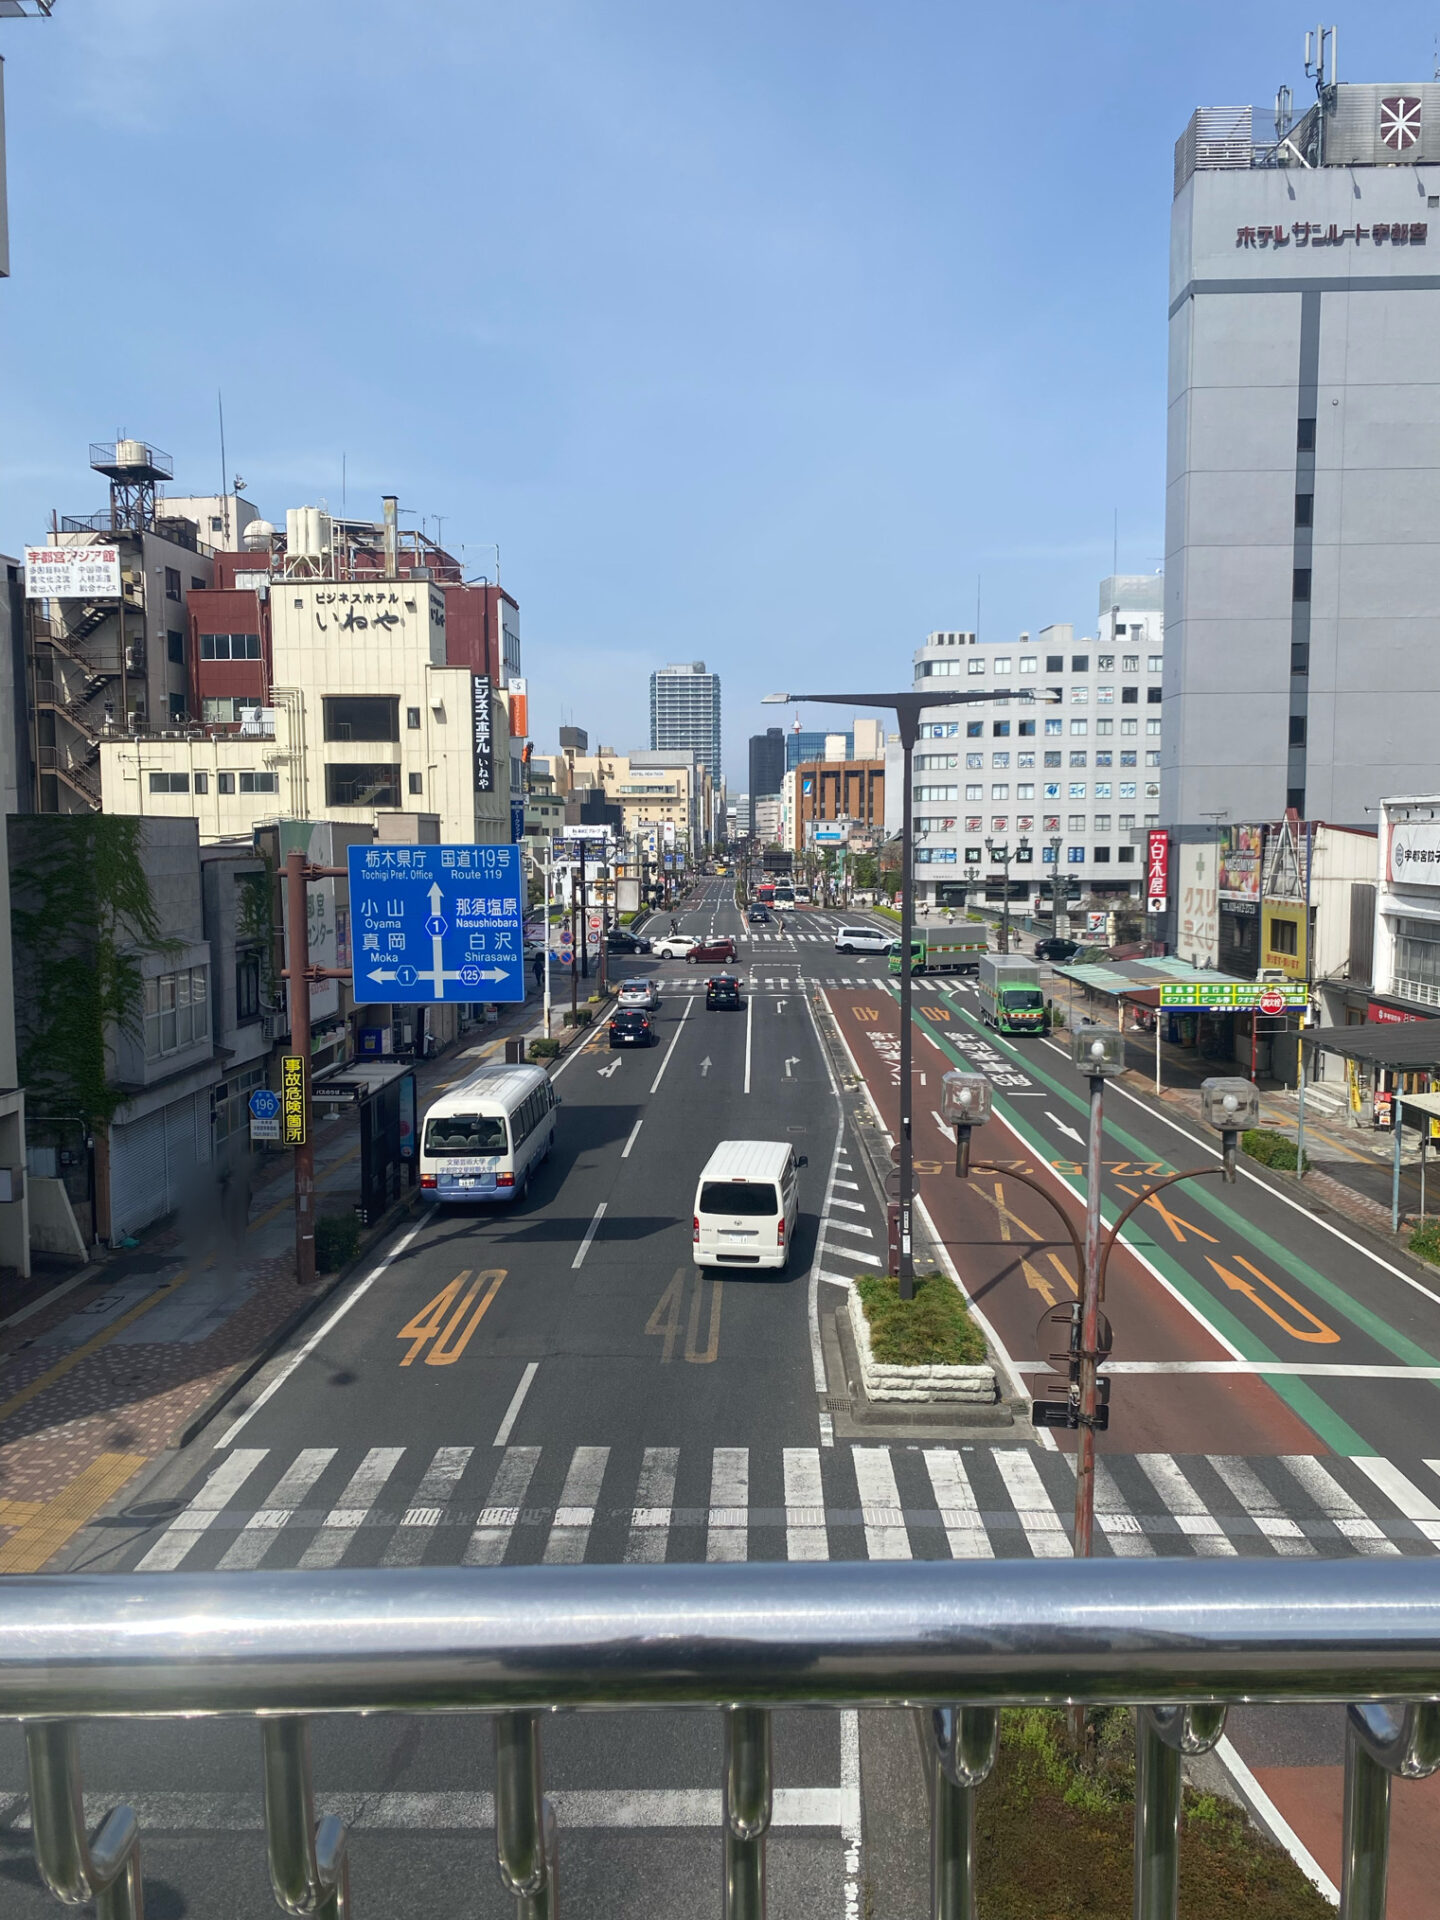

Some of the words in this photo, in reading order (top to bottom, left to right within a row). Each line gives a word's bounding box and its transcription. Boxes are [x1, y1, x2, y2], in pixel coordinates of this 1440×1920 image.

[1237, 222, 1427, 247] ホテルサンルート宇都宮
[28, 550, 115, 564] 宇都宮アジア館
[316, 593, 399, 604] ビジネスホテル
[316, 605, 400, 633] いねや
[475, 677, 490, 754] ビジネスホテル
[478, 758, 489, 789] いねや
[941, 819, 1057, 833] アデランス
[365, 850, 427, 868] 栃木県庁
[441, 849, 511, 868] 国道119号
[1149, 842, 1167, 894] 白木屋
[361, 870, 389, 881] Tochigi
[391, 870, 409, 880] Pref.
[411, 870, 433, 880] Office
[451, 870, 481, 879] Route
[485, 870, 502, 879] 119
[361, 899, 404, 917] 小山
[456, 898, 518, 916] 那須塩原
[1184, 888, 1217, 918] クスリ
[365, 919, 401, 930] Oyama
[433, 922, 439, 933] 1
[456, 918, 518, 928] Nasushiobara
[362, 933, 406, 951] 真岡
[470, 932, 512, 950] 白沢
[370, 953, 398, 963] Moka
[464, 952, 517, 962] Shirasawa
[403, 970, 409, 981] 1
[463, 970, 478, 980] 125
[1262, 999, 1281, 1008] 消火栓
[852, 1007, 880, 1021] 40
[920, 1007, 950, 1021] 40
[255, 1099, 274, 1110] 196
[285, 1059, 302, 1141] 事故危険箇所
[396, 1268, 508, 1367] 40
[643, 1267, 724, 1364] 40
